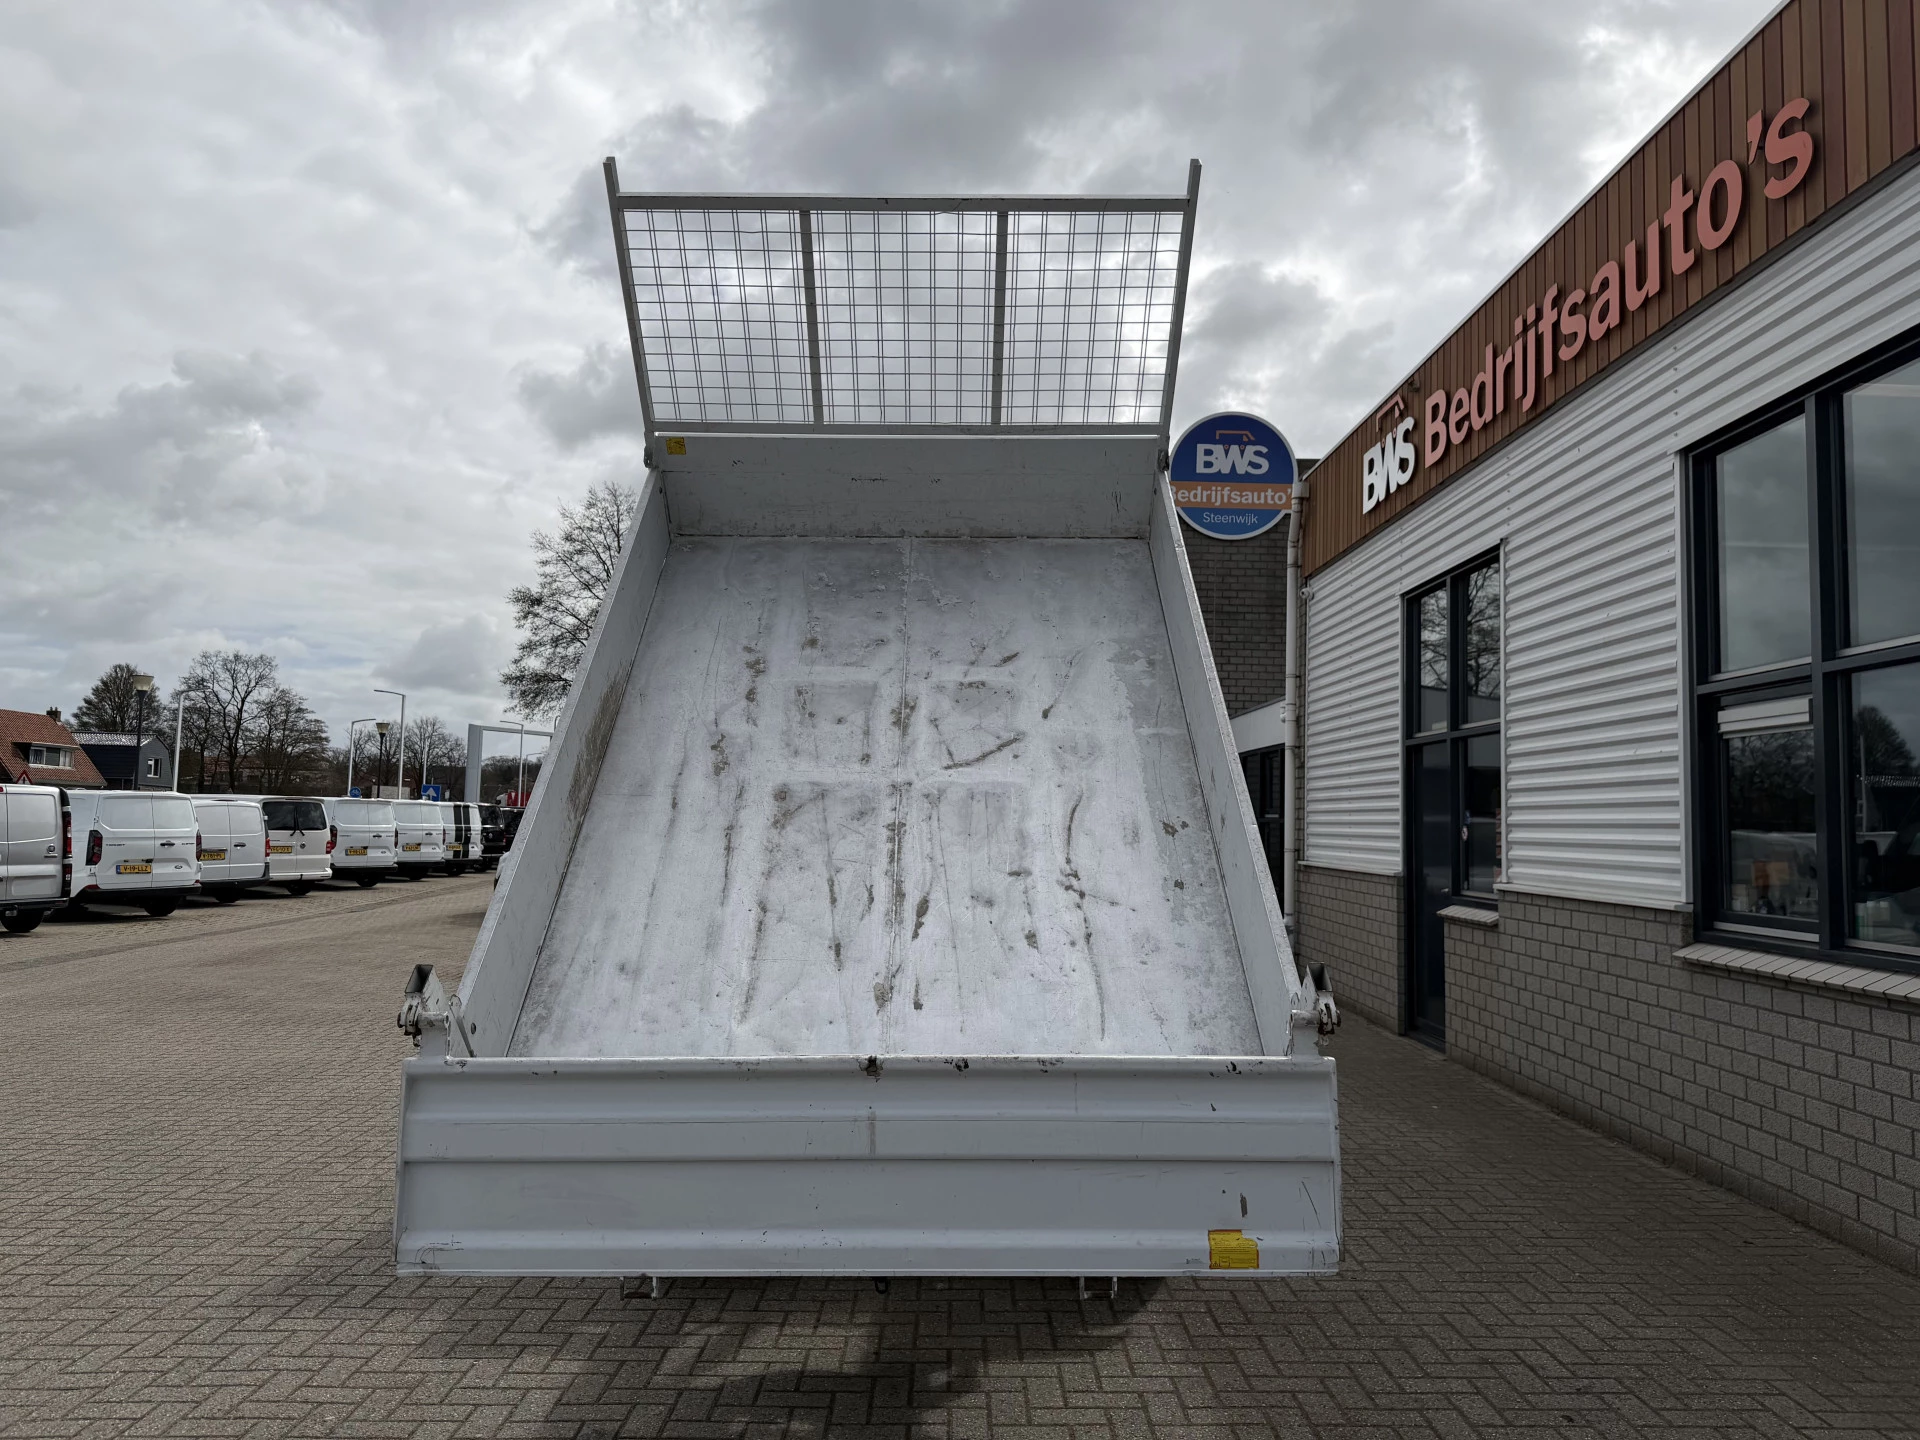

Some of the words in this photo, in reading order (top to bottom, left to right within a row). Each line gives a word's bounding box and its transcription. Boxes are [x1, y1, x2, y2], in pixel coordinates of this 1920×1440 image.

[1363, 417, 1415, 514] BWS
[1425, 98, 1814, 468] Bedrijfsauto's
[1196, 443, 1269, 475] BWS
[1203, 511, 1258, 525] Steenwijk
